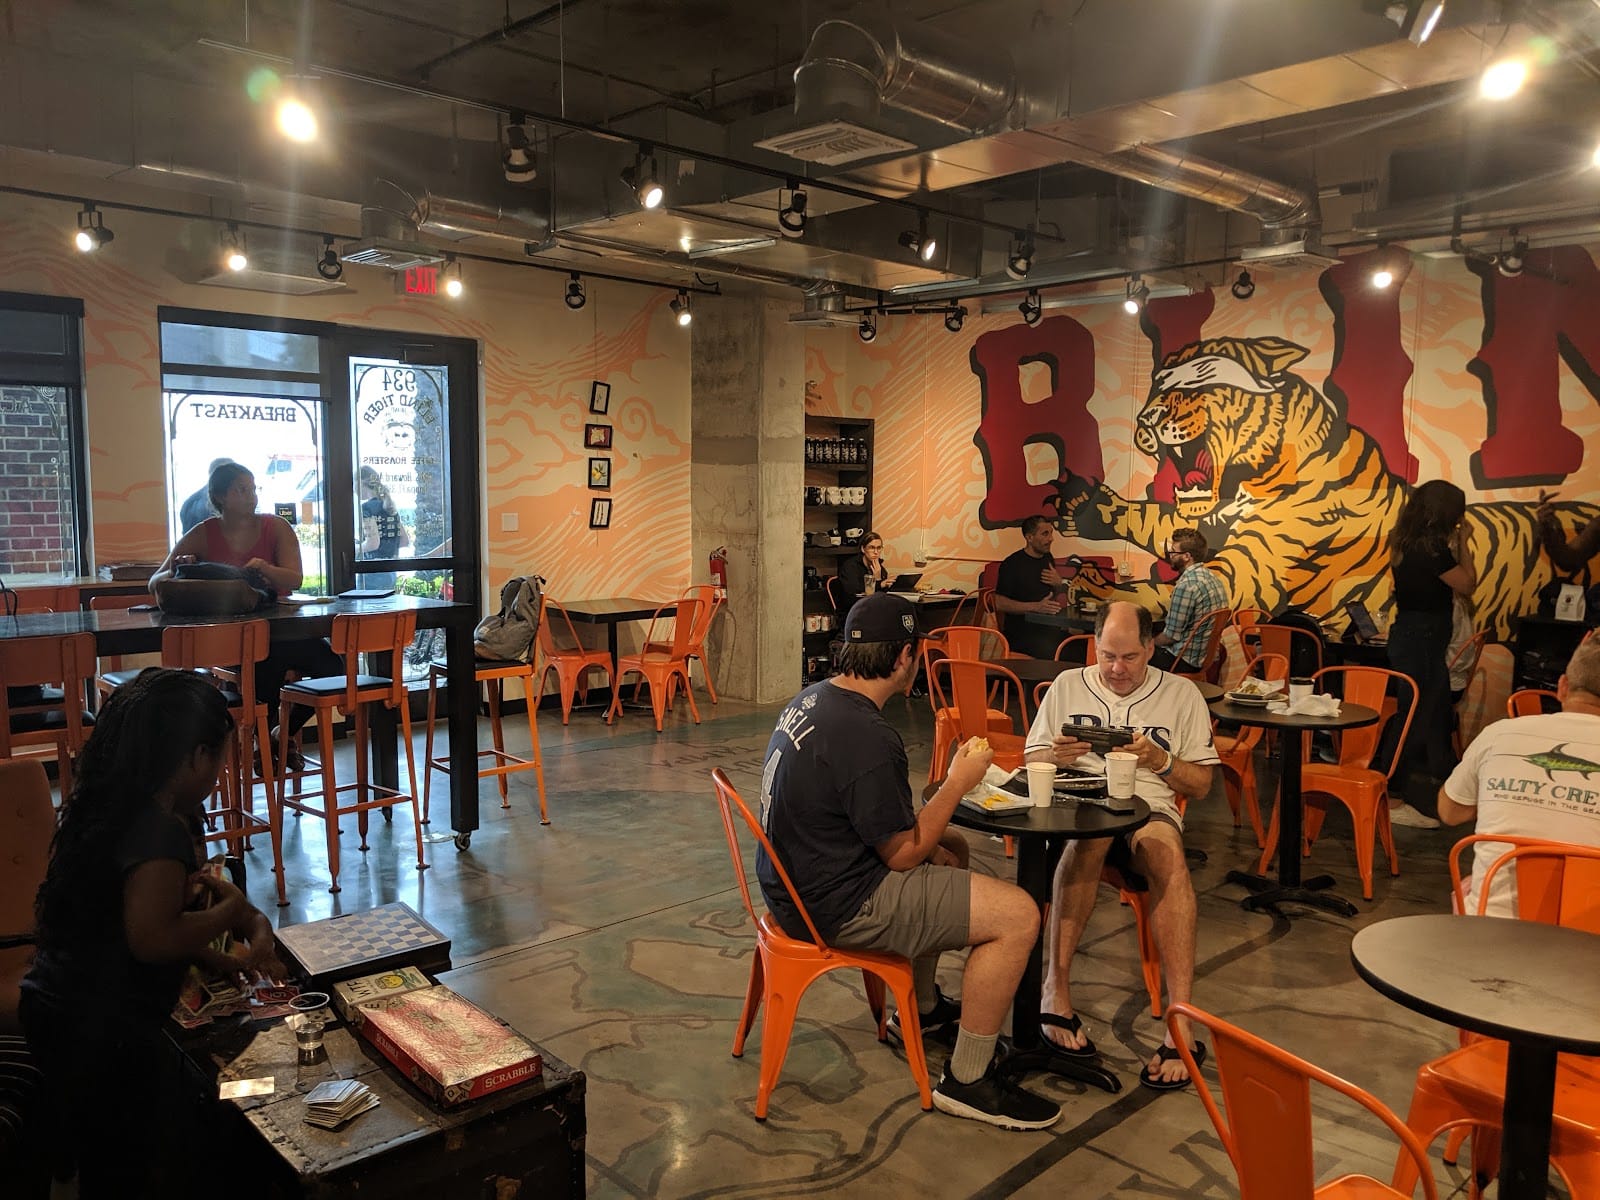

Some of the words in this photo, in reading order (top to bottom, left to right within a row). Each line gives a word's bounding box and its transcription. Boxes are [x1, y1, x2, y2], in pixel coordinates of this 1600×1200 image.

[405, 266, 438, 296] EXIT
[775, 707, 816, 752] SNELL
[1068, 714, 1172, 751] RS
[1486, 777, 1547, 795] SALTY
[1561, 802, 1578, 811] THE
[484, 1063, 536, 1088] SCRABBLE
